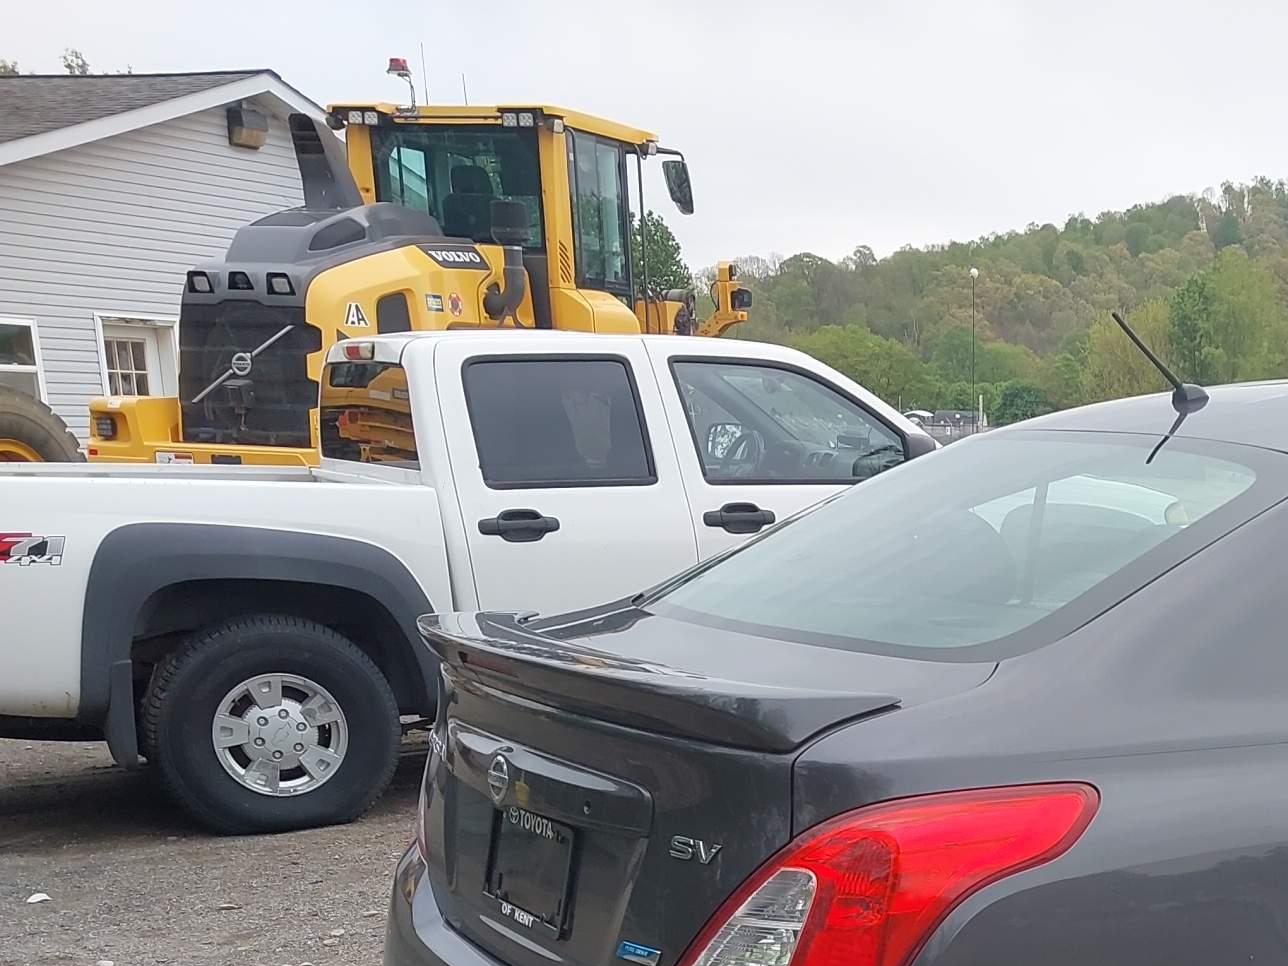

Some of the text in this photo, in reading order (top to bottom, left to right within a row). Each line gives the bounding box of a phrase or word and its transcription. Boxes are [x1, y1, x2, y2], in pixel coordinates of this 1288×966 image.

[428, 250, 481, 263] VOLVO
[519, 809, 554, 840] TOYOTA
[669, 835, 722, 864] SV
[501, 902, 534, 928] OF KENT
